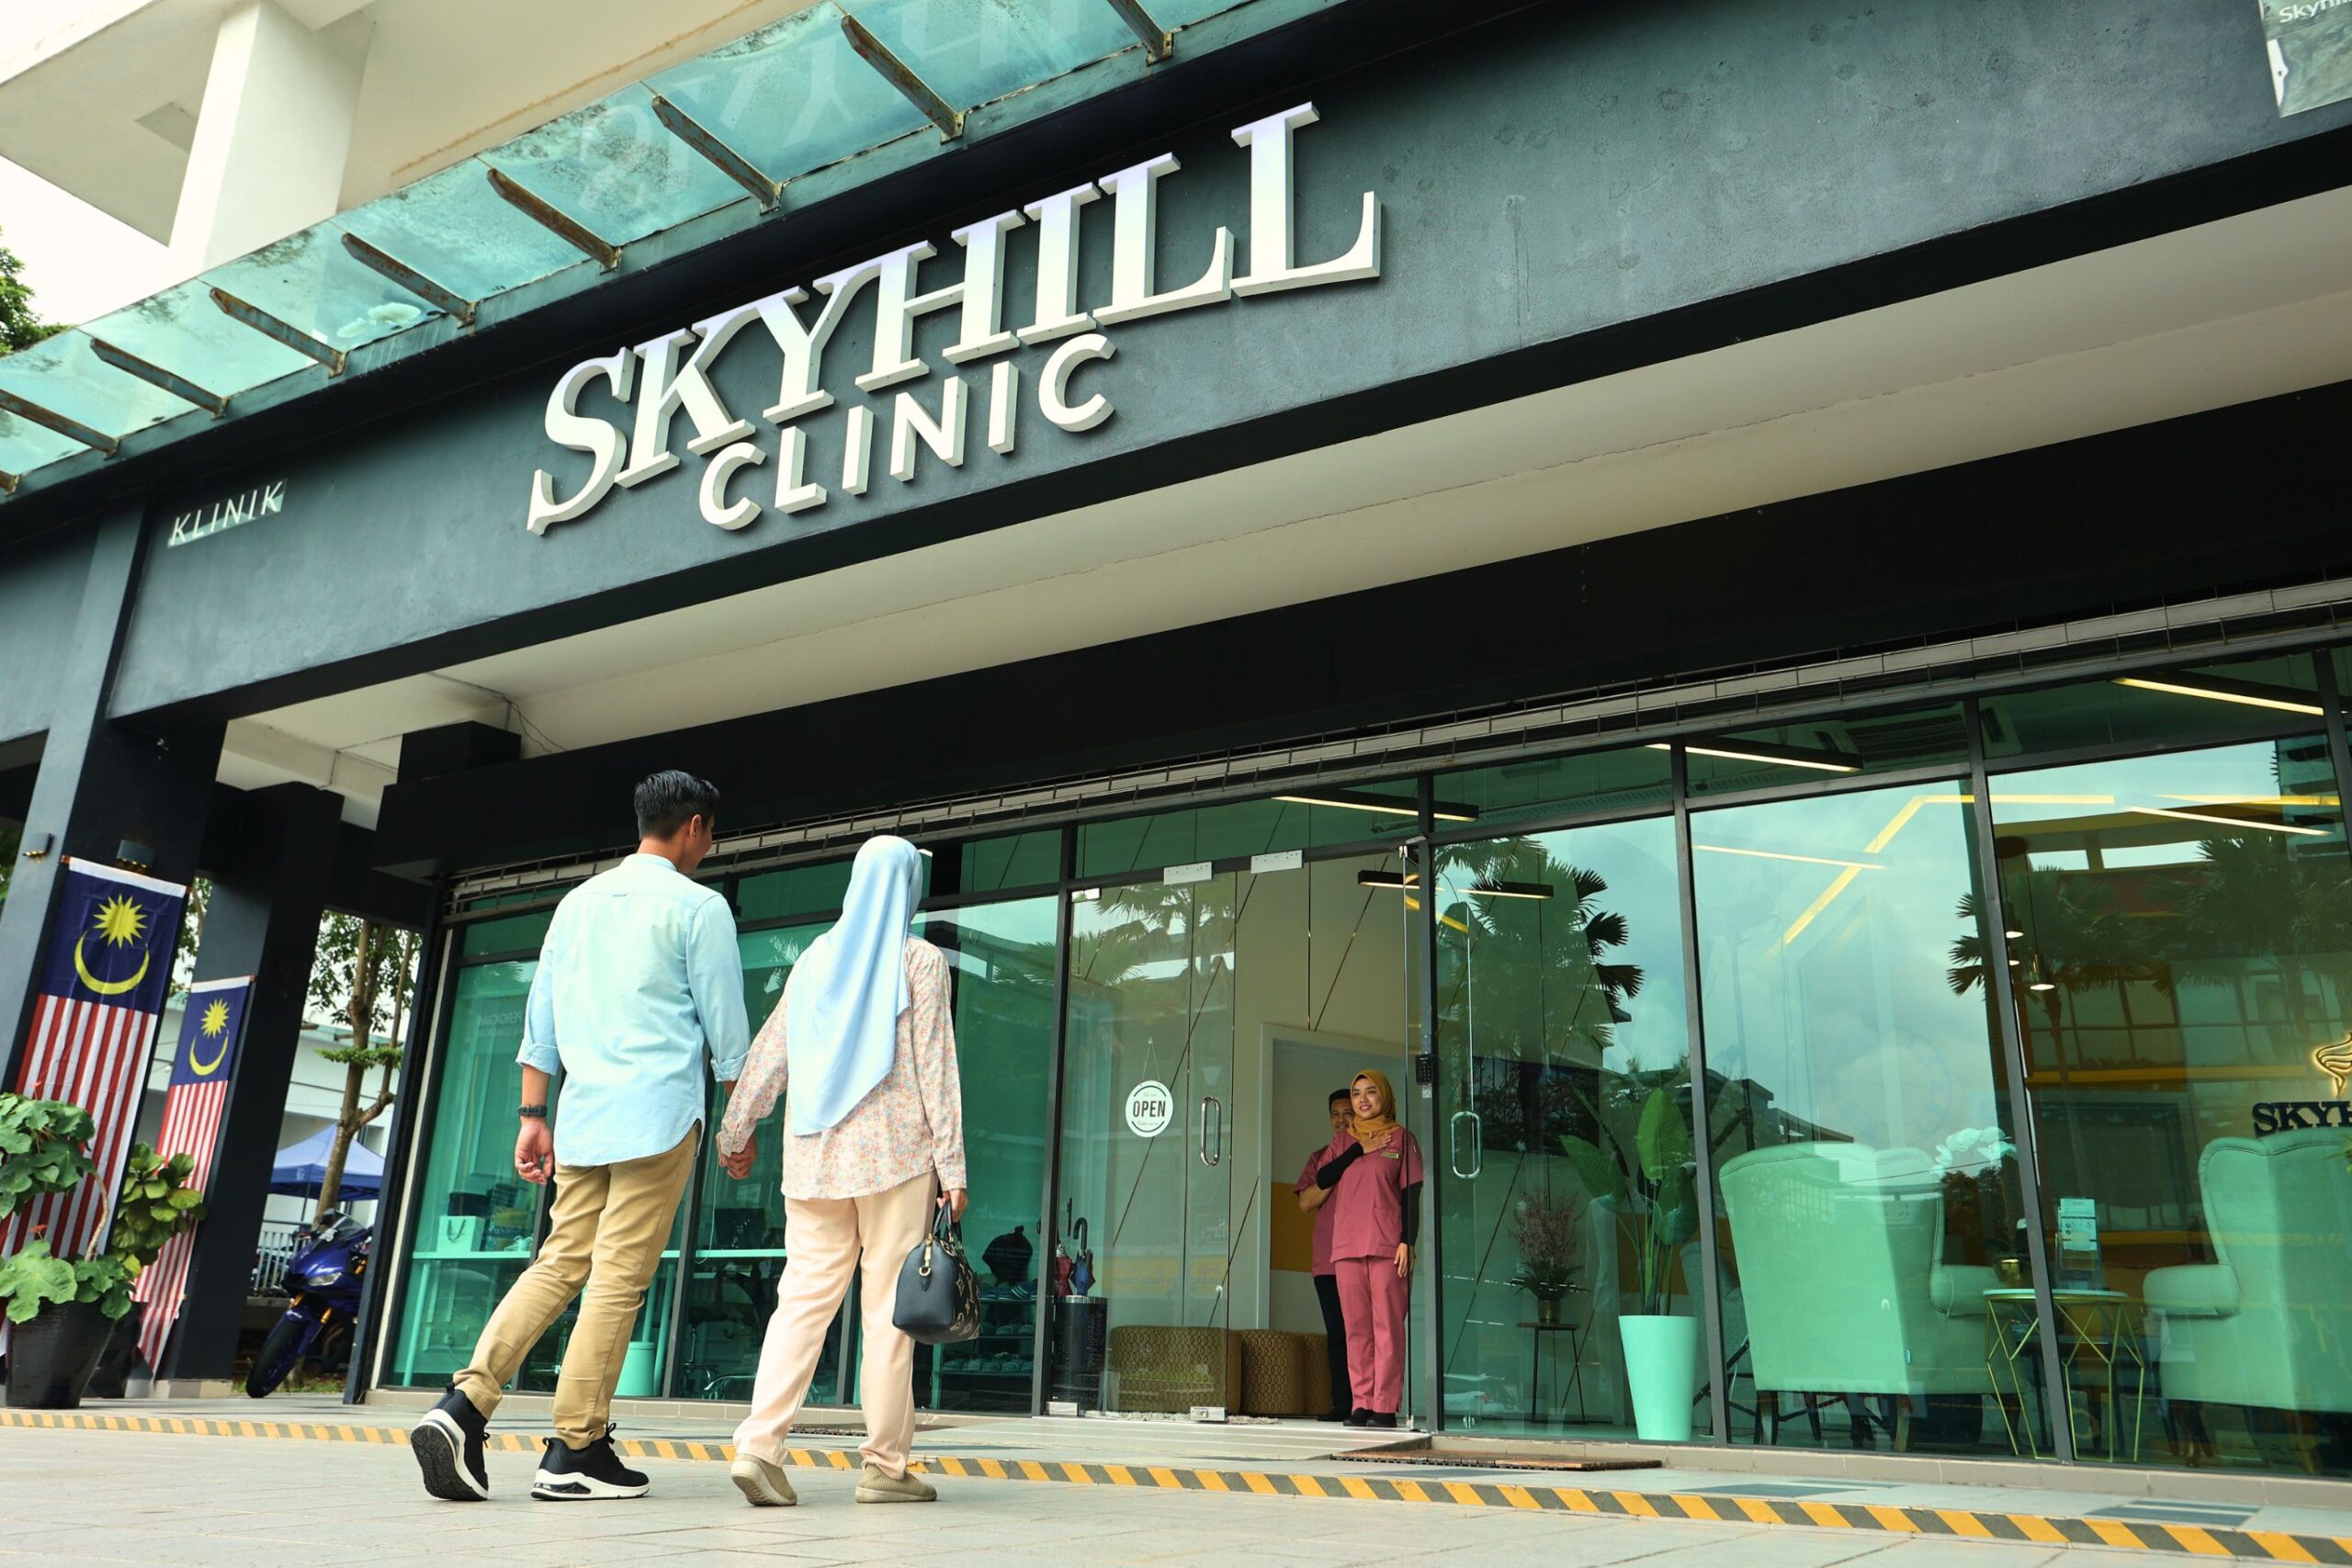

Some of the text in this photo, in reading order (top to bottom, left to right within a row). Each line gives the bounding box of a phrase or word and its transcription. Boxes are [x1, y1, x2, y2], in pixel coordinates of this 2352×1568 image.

[526, 101, 1382, 536] SKYHILL
[699, 333, 1115, 531] CLINIC
[169, 481, 283, 547] KLINIK
[1133, 1100, 1166, 1118] OPEN
